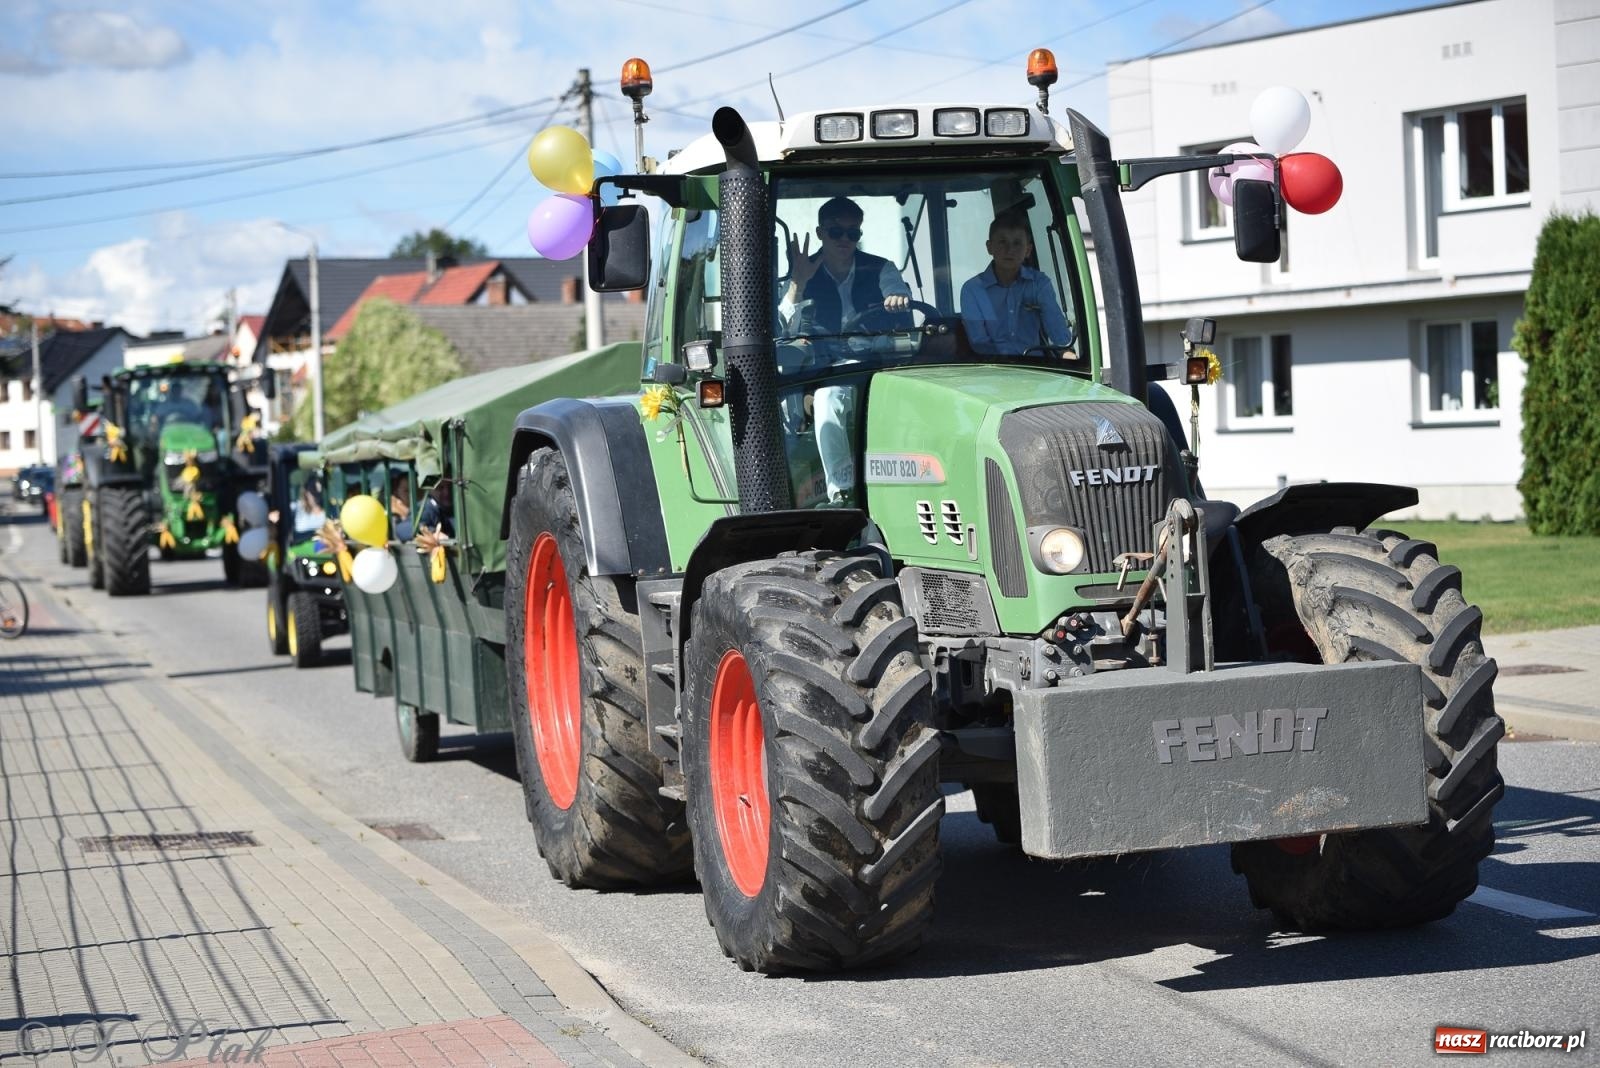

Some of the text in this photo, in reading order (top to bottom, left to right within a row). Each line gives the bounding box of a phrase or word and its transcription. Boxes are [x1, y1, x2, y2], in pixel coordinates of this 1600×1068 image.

[870, 460, 897, 477] FENDT
[899, 460, 917, 477] 820
[1069, 465, 1158, 487] FENDT
[1153, 707, 1329, 764] FENDT
